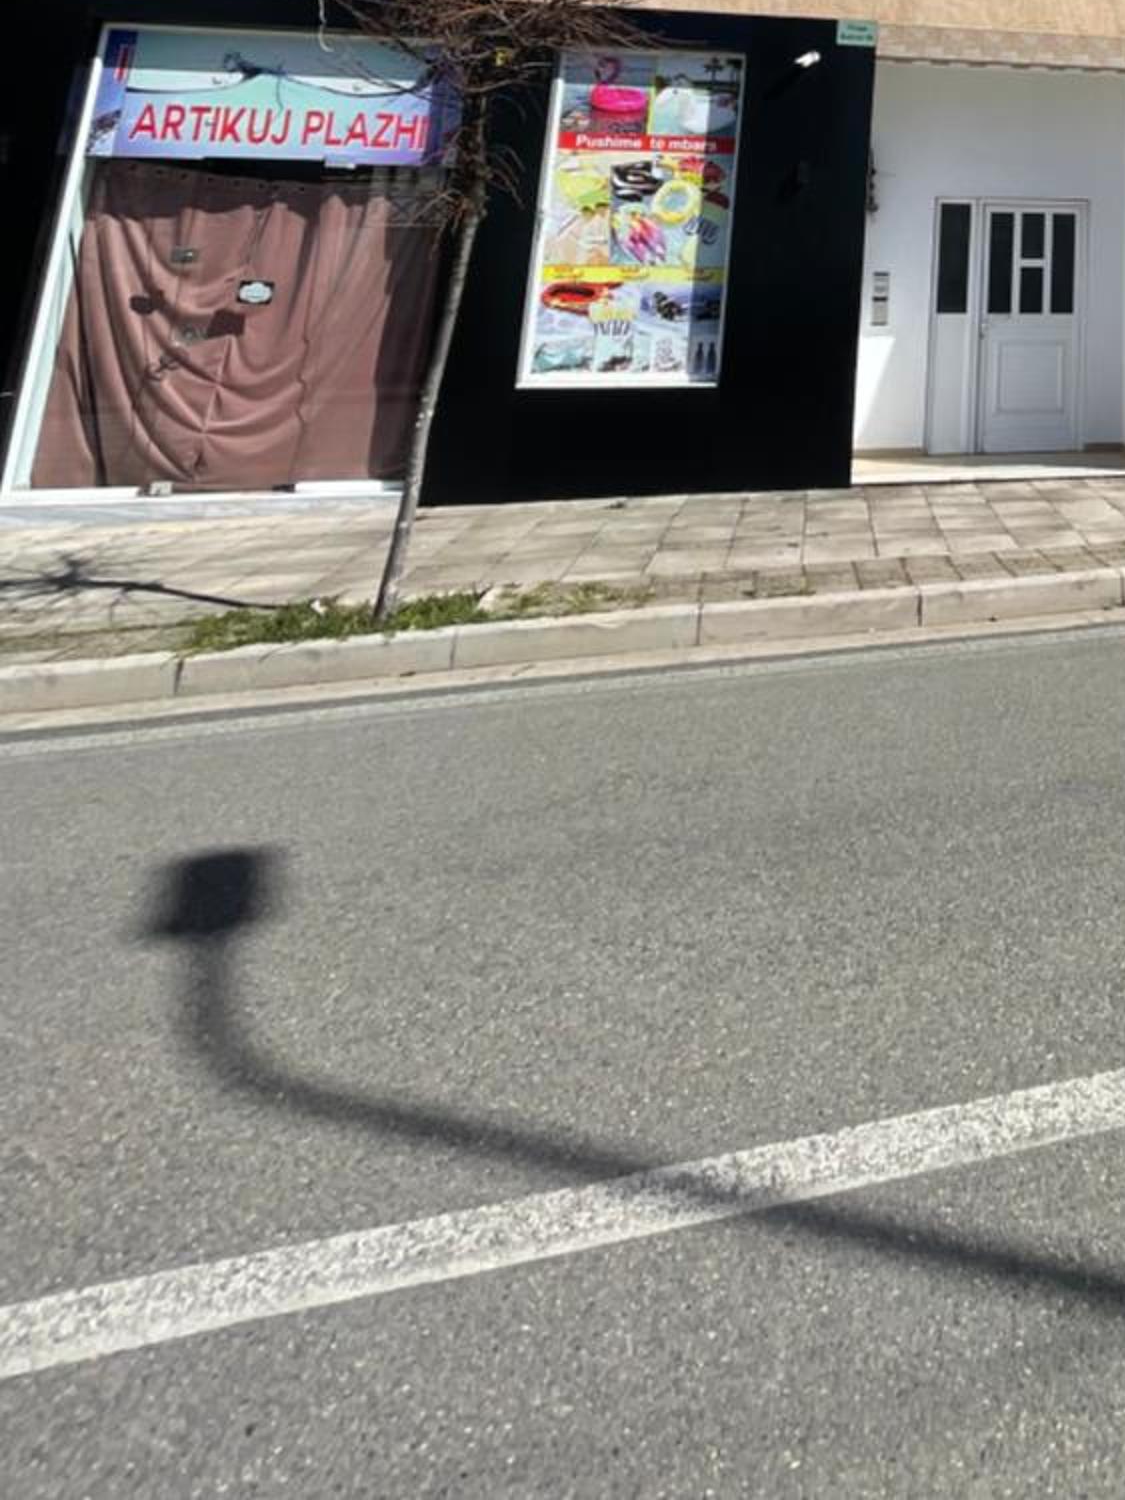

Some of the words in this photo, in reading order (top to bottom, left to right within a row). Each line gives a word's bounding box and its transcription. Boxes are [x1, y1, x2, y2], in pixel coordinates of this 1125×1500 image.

[128, 103, 292, 145] ARTIKUJ
[301, 110, 429, 150] PLAZHI
[575, 134, 642, 150] Pushime
